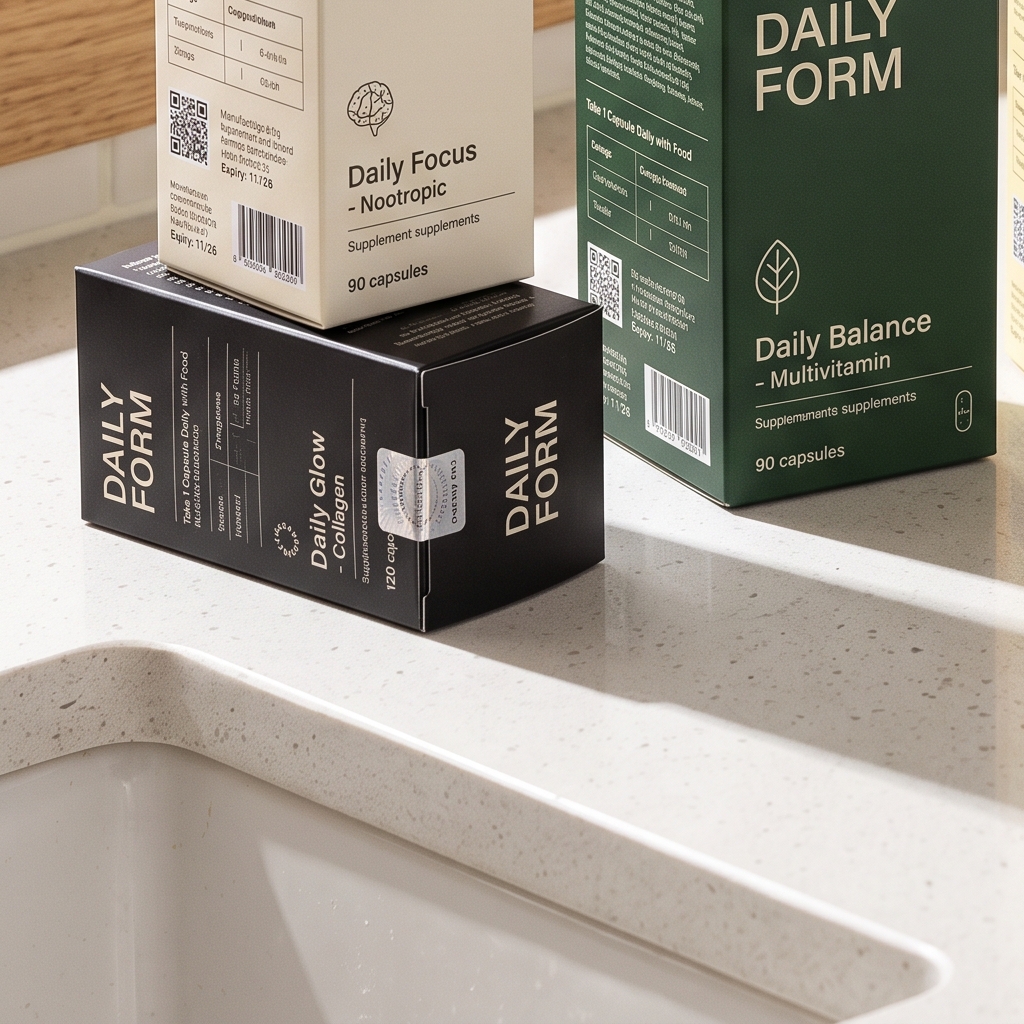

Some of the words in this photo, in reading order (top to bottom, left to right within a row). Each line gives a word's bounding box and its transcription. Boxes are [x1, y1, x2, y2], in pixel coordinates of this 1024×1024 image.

[756, 46, 902, 112] FORM
[349, 157, 404, 188] Daily
[411, 144, 477, 174] Focus
[655, 137, 672, 152] with
[673, 143, 692, 161] Food
[361, 179, 447, 214] Nootropic
[195, 239, 217, 256] 11/26
[348, 228, 412, 253] Supplement
[415, 213, 480, 240] supplements
[348, 276, 366, 293] 90
[369, 264, 429, 288] capsules
[756, 330, 821, 362] Daily
[829, 313, 932, 350] Balance
[770, 351, 891, 389] Multivitamin
[841, 390, 917, 415] supplements
[100, 381, 127, 505] DAILY
[129, 389, 155, 514] FORM
[308, 430, 326, 497] Glow
[534, 399, 559, 526] FORM
[755, 456, 775, 472] 90
[779, 445, 845, 468] capsules
[504, 417, 530, 537] DAILY
[309, 503, 331, 570] Daily
[331, 474, 349, 560] Collagen
[385, 566, 396, 591] 120
